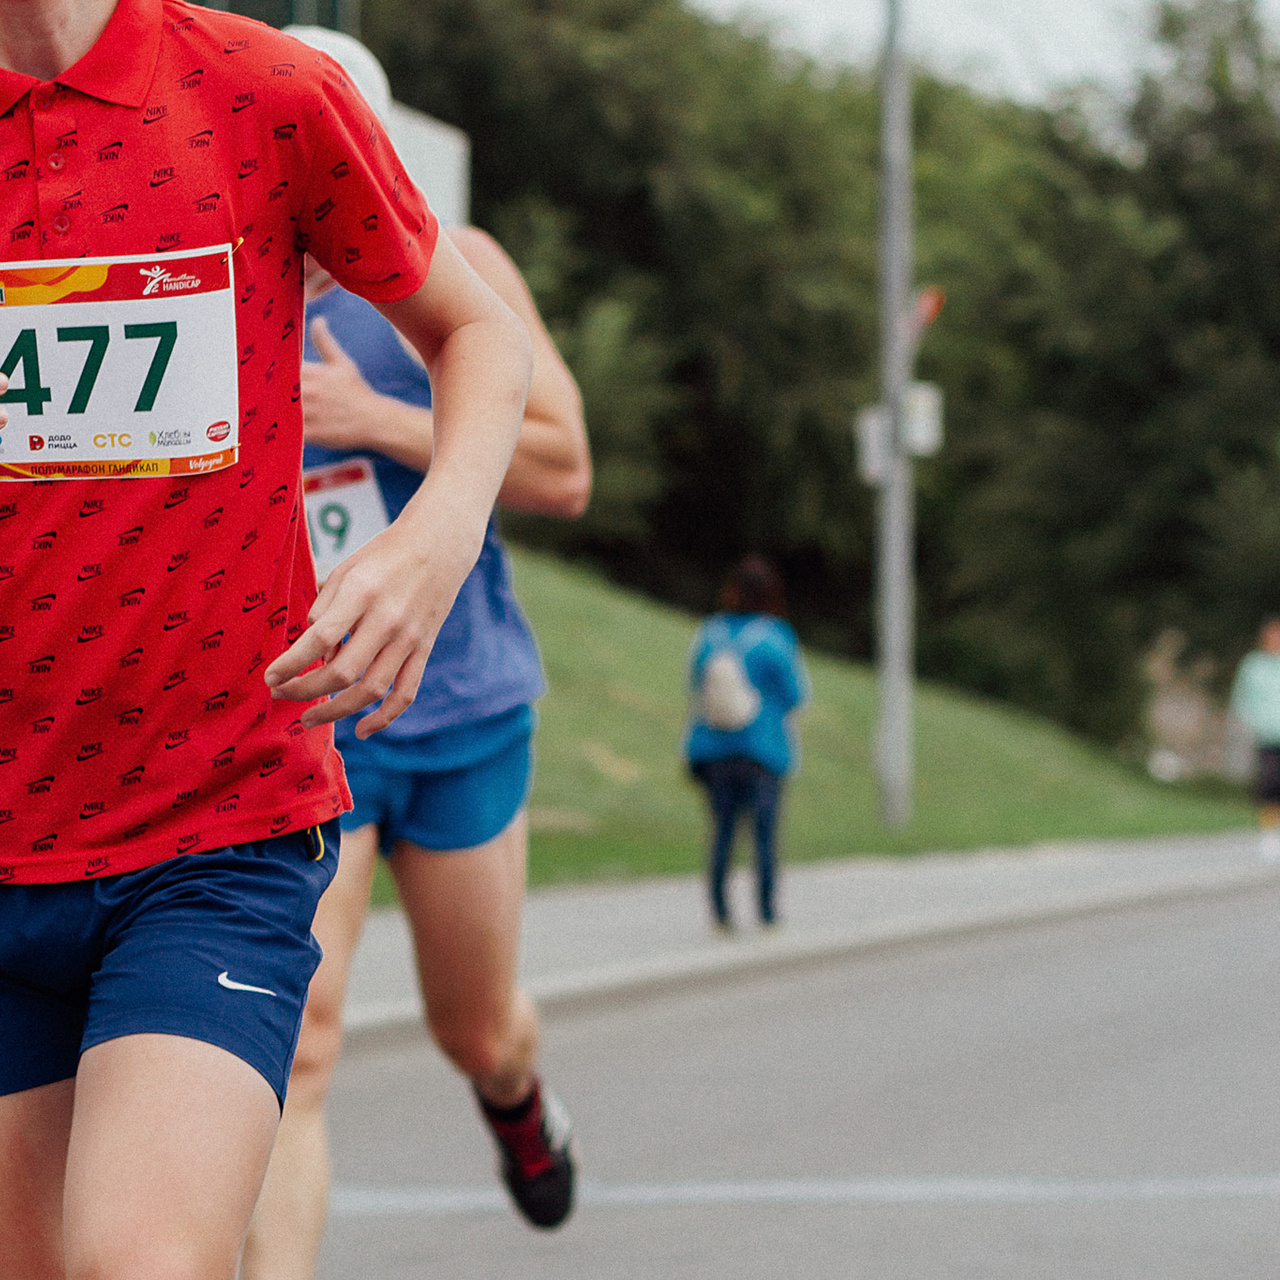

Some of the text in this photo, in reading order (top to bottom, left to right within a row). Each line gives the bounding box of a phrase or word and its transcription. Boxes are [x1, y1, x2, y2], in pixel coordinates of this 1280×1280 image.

[181, 79, 201, 90] NIKE
[235, 92, 255, 103] NIKE
[146, 106, 167, 116] NIKE
[190, 139, 209, 149] NIKE
[99, 150, 119, 161] NIKE
[6, 170, 27, 181] NIKE
[153, 167, 174, 178] NIKE
[197, 202, 217, 212] NIKE
[103, 213, 125, 223] NIKE
[11, 230, 32, 241] NIKE
[160, 233, 181, 242] NIKE
[163, 279, 201, 291] HANDICAP
[48, 434, 72, 442] ДОДО
[48, 442, 78, 450] ПИЦЦА
[31, 463, 158, 475] ПОЛУМАРАФОН ГАНДИКАП
[169, 488, 189, 500] NIKE
[83, 500, 104, 509] NIKE
[81, 564, 101, 573] NIKE
[245, 591, 267, 603] NIKE
[168, 610, 189, 621] NIKE
[81, 625, 103, 634] NIKE
[81, 687, 103, 697] NIKE
[168, 730, 189, 740] NIKE
[81, 742, 103, 752] NIKE
[262, 757, 282, 770] NIKE
[176, 789, 198, 801] NIKE
[84, 802, 105, 811] NIKE
[179, 833, 200, 844] NIKE
[88, 856, 109, 867] NIKE
